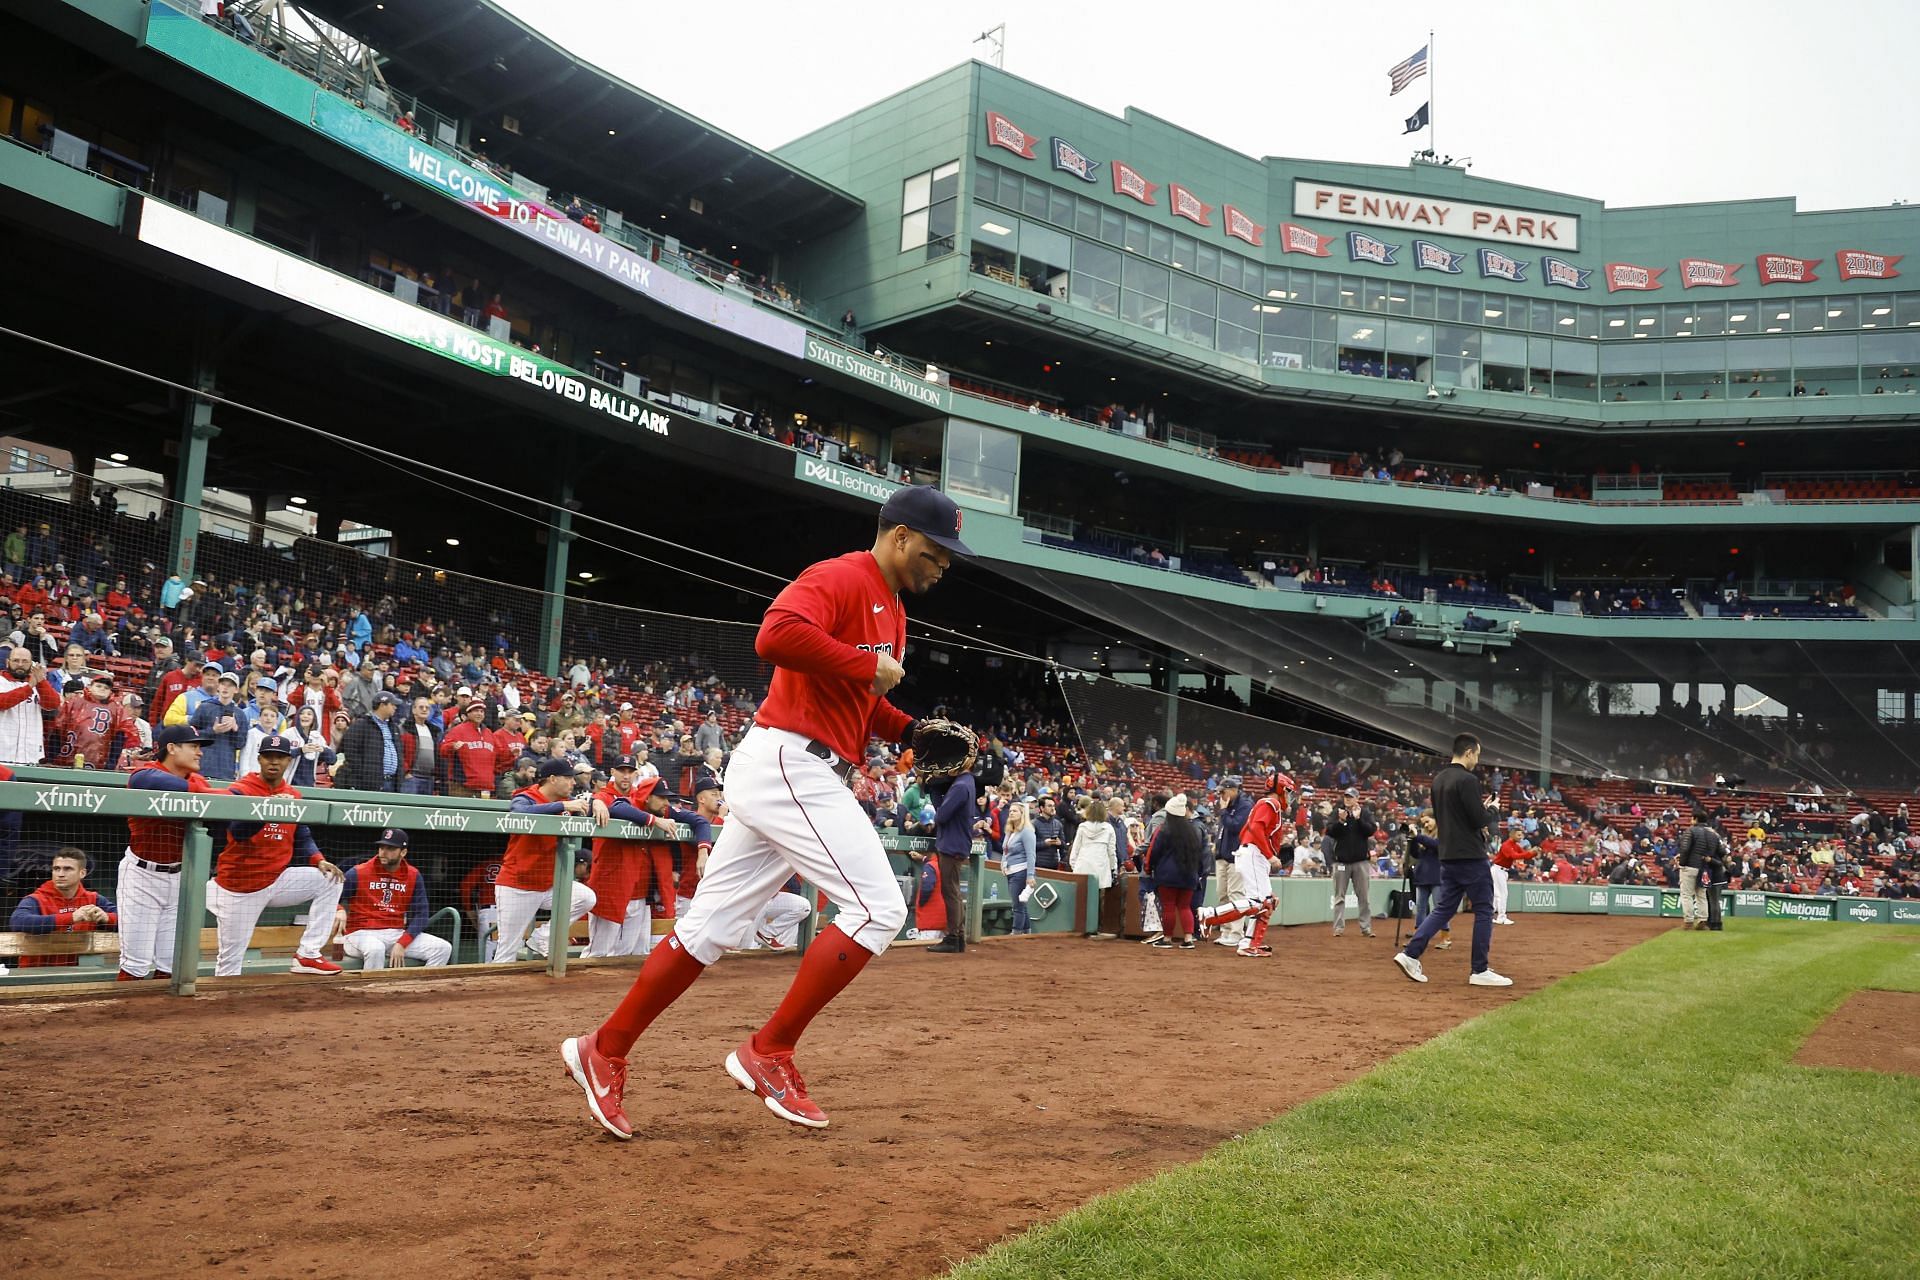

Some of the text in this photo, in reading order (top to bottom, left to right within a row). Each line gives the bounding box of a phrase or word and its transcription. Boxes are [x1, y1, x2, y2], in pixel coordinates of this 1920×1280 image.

[408, 146, 652, 288] WELCOME TO FENWAY PARK
[1315, 190, 1558, 241] FENWAY PARK
[1688, 266, 1725, 280] 2007
[1766, 261, 1804, 276] 2013
[1846, 257, 1885, 271] 2018
[1613, 269, 1649, 285] 2004
[808, 341, 941, 406] STATE STREET PAVILION
[453, 332, 506, 370] MOST
[509, 355, 586, 403] BELOVED
[589, 387, 671, 436] BALLPARK
[805, 459, 840, 486] DELL
[87, 708, 112, 735] B
[34, 786, 107, 813] xfinity
[148, 792, 212, 818] xfinity
[251, 799, 307, 822] xfinity
[343, 802, 393, 827] xfinity
[424, 813, 470, 832] xfinity
[495, 814, 537, 834] xfinity
[560, 817, 597, 836] xfinity
[620, 822, 655, 839] xfinity
[909, 836, 930, 851] xfinity
[369, 881, 407, 893] RED SOX
[1525, 890, 1557, 907] WM
[1747, 894, 1765, 902] MGM
[1781, 902, 1829, 917] National
[1850, 907, 1878, 917] IRVING
